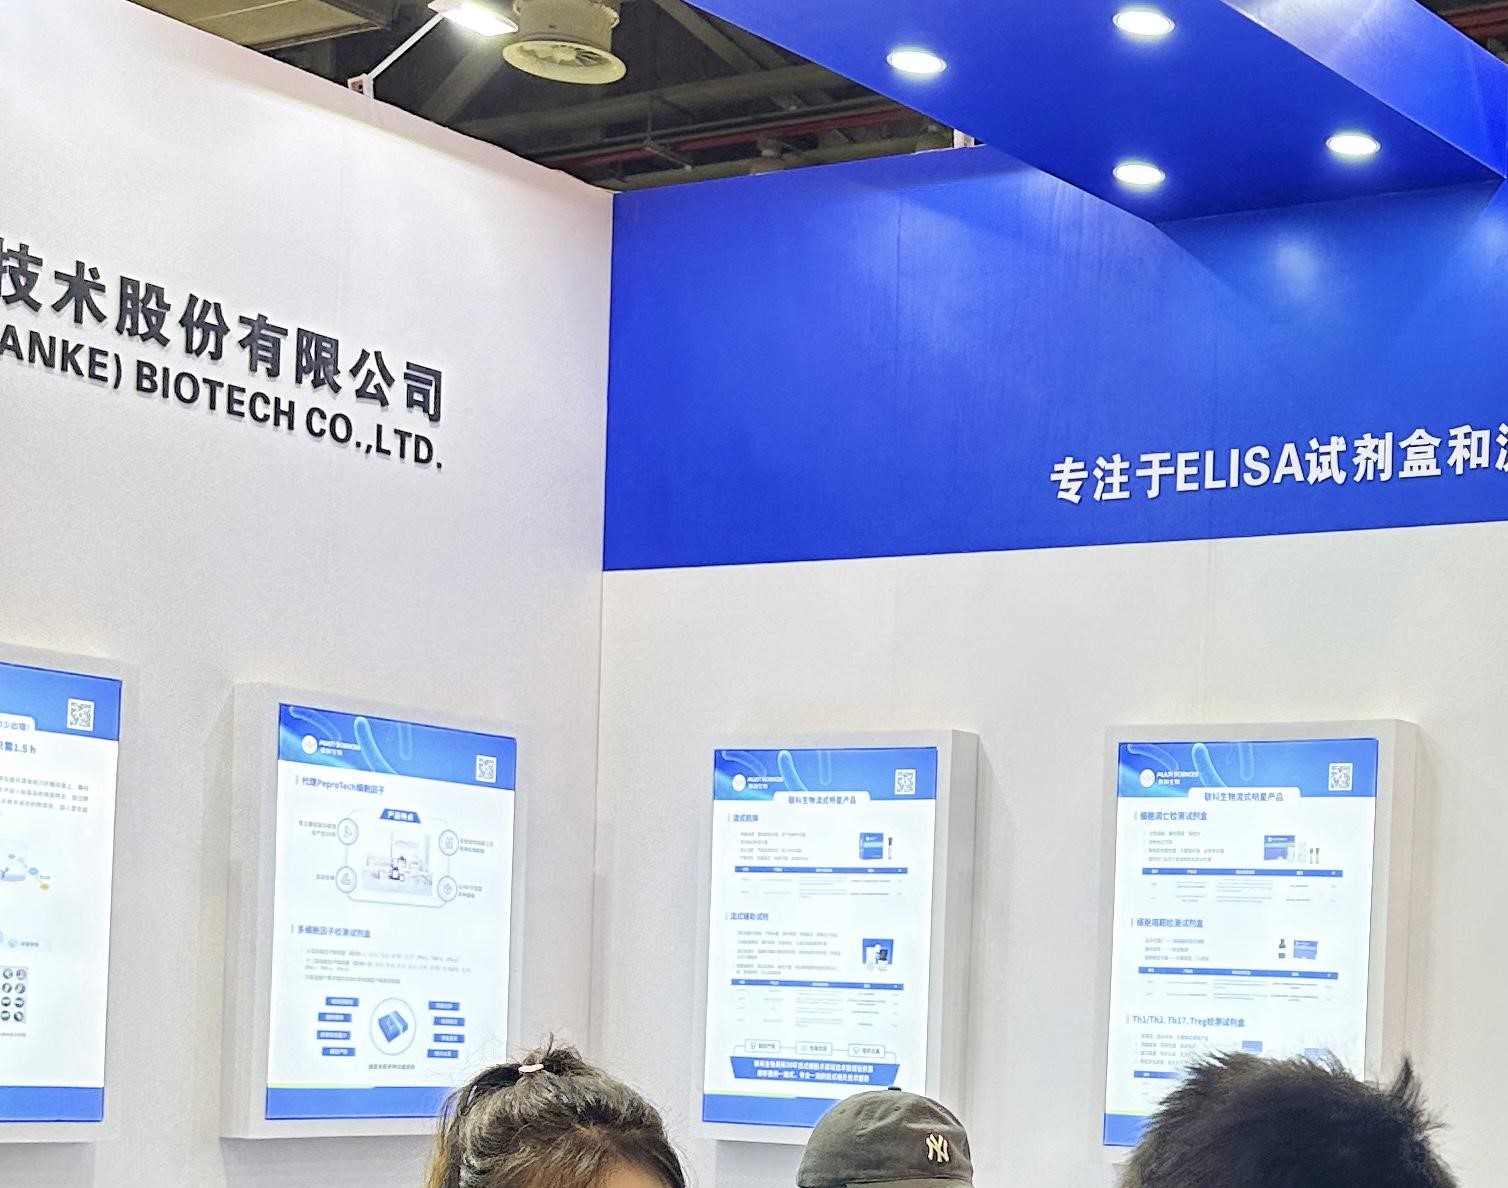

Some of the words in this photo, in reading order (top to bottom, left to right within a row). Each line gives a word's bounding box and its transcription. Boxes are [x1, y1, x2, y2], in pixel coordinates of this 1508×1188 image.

[135, 358, 296, 431] BIOTECH
[305, 405, 444, 470] CO.,LTD.
[925, 1133, 950, 1163] NY
